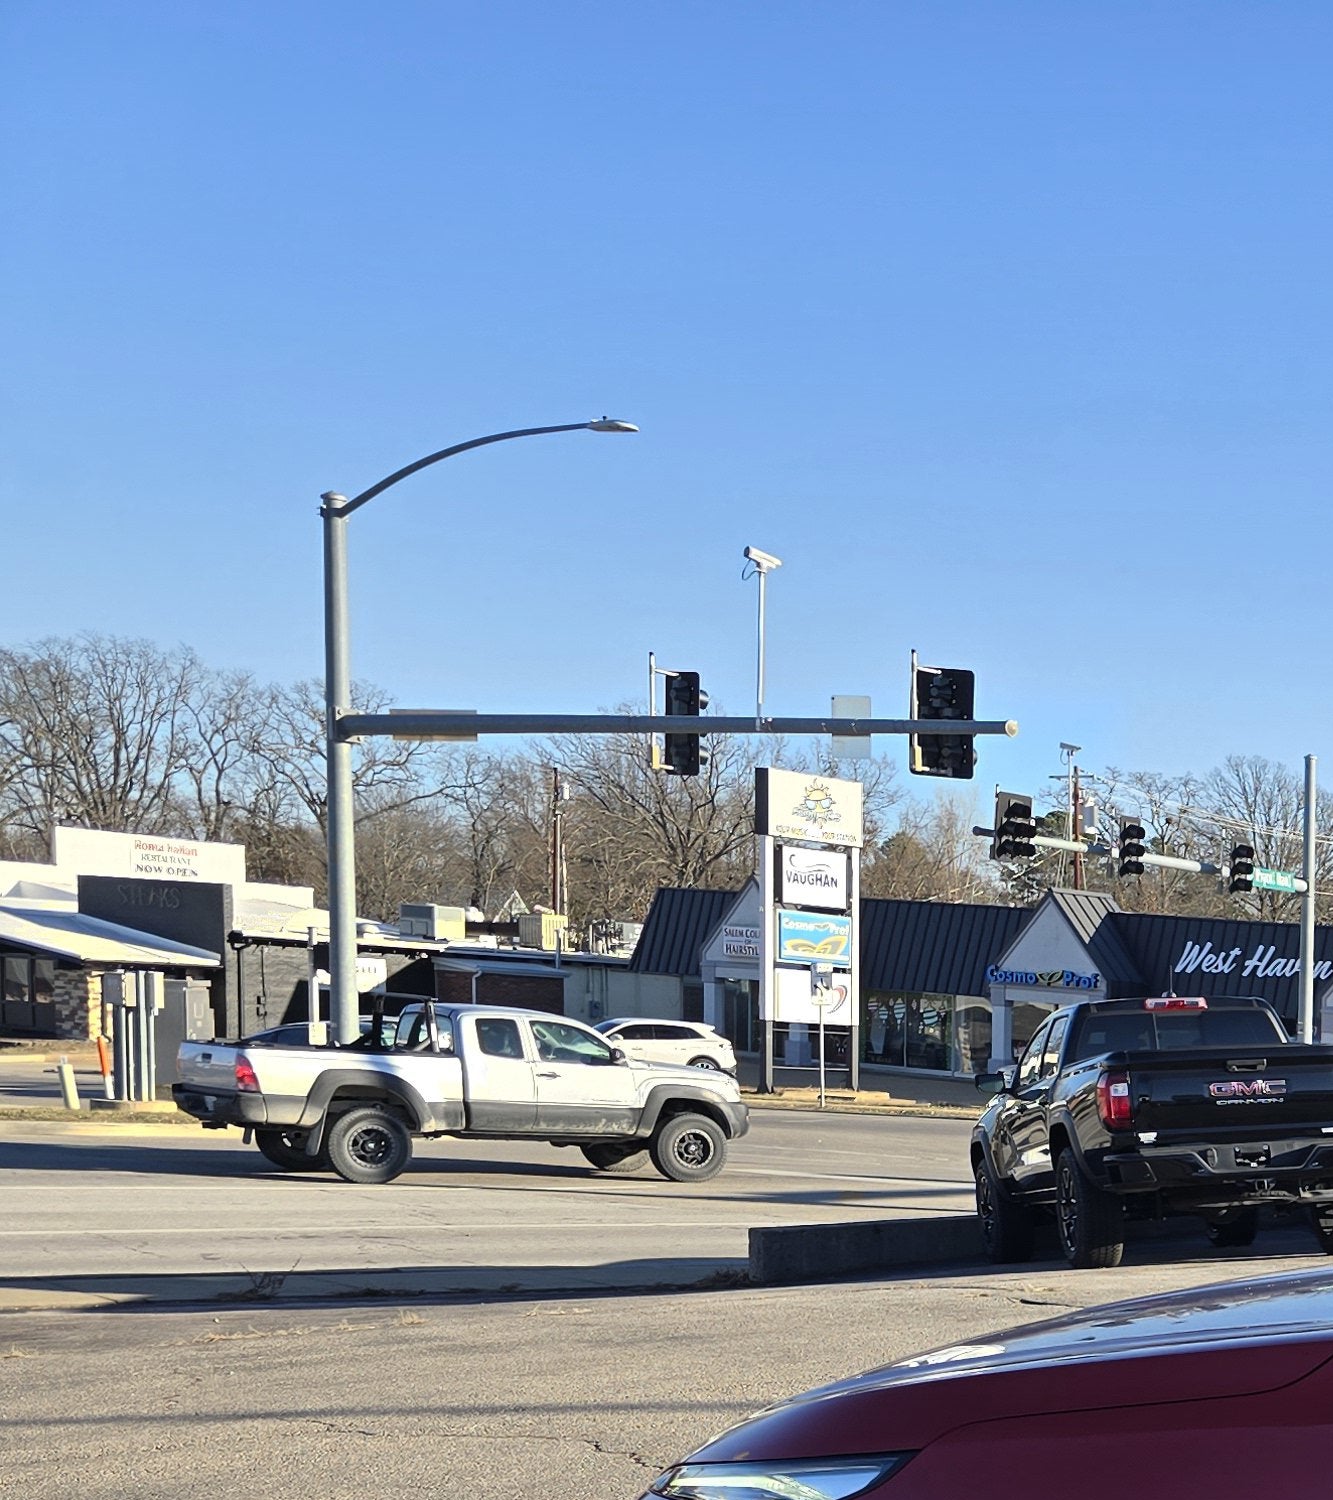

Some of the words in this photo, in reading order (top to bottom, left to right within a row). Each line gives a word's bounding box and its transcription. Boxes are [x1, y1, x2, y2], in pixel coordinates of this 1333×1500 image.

[141, 853, 191, 866] RESTAURANT
[135, 864, 162, 874] NOW
[166, 866, 198, 877] OPEN
[786, 870, 838, 888] VAUGHAN
[783, 916, 815, 931] Cosmo
[725, 943, 760, 956] HAIRSTYL
[1174, 940, 1242, 974] West
[1242, 944, 1333, 980] Havn
[985, 964, 1038, 985] Cosmo
[1062, 969, 1100, 989] Prof
[1208, 1079, 1287, 1097] GMC
